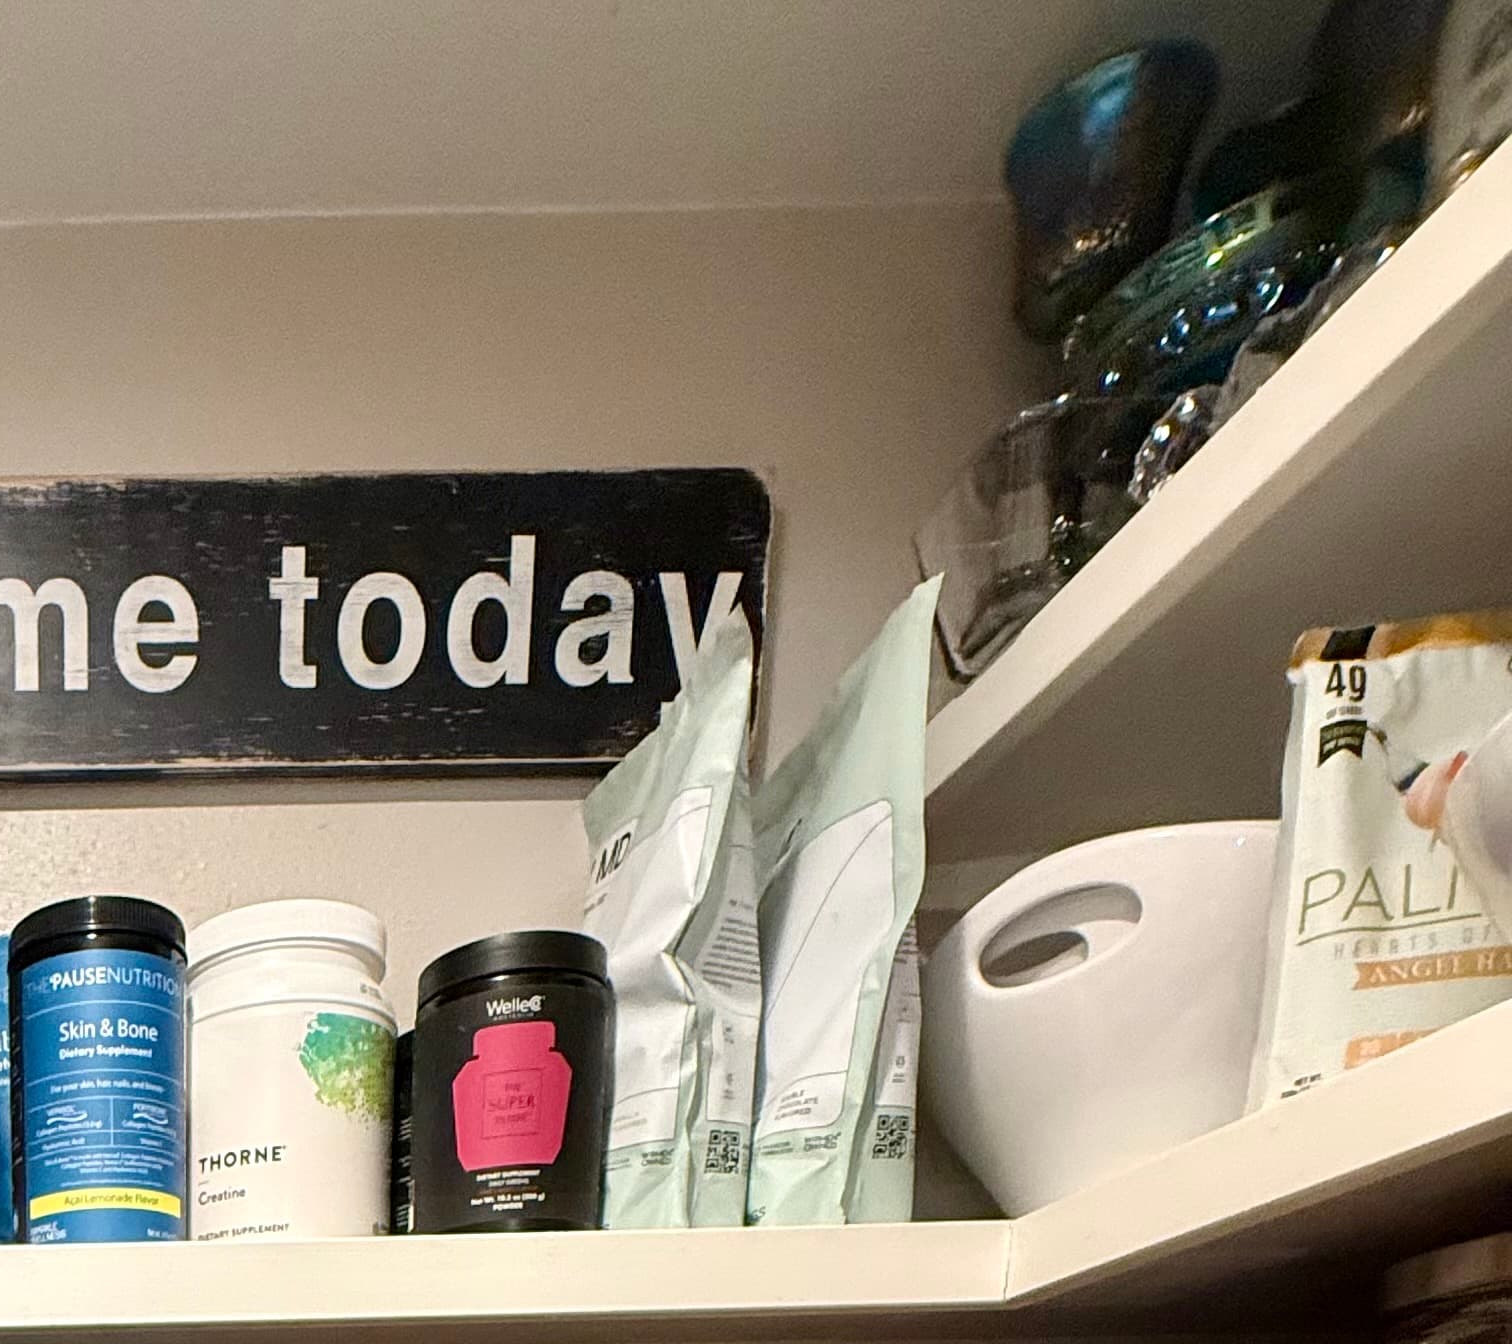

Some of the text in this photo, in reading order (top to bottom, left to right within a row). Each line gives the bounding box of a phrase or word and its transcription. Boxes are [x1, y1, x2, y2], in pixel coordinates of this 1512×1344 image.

[269, 534, 744, 700] today
[1325, 664, 1367, 702] 4g
[59, 1018, 159, 1041] Skin & Bone
[59, 1044, 153, 1060] Dietary Supplement
[199, 1145, 285, 1174] THORNE
[198, 1187, 247, 1207] Creatine
